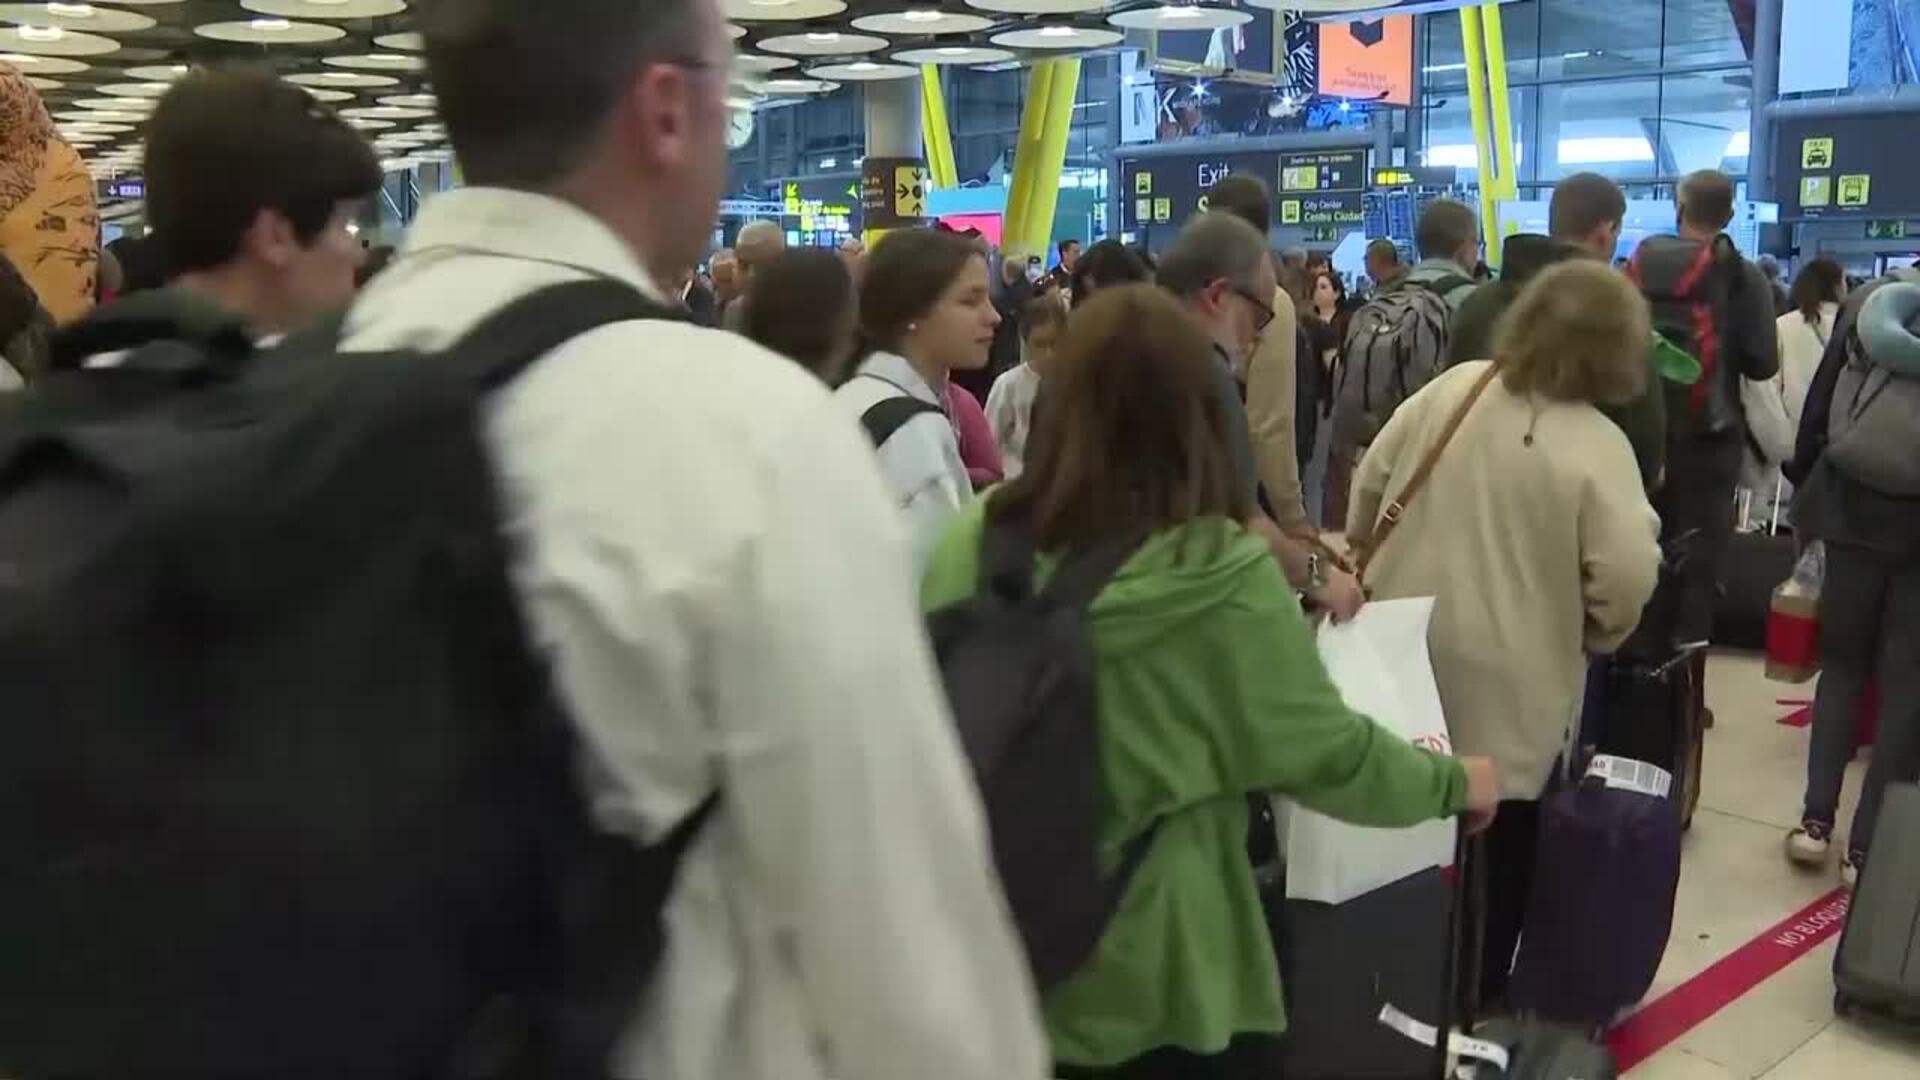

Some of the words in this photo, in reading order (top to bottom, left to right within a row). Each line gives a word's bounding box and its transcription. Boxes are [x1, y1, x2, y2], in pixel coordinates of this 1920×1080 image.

[1198, 162, 1230, 187] Exit
[1303, 200, 1318, 211] City
[1319, 200, 1343, 209] Center
[1304, 211, 1332, 222] Centro
[1775, 930, 1806, 948] NO
